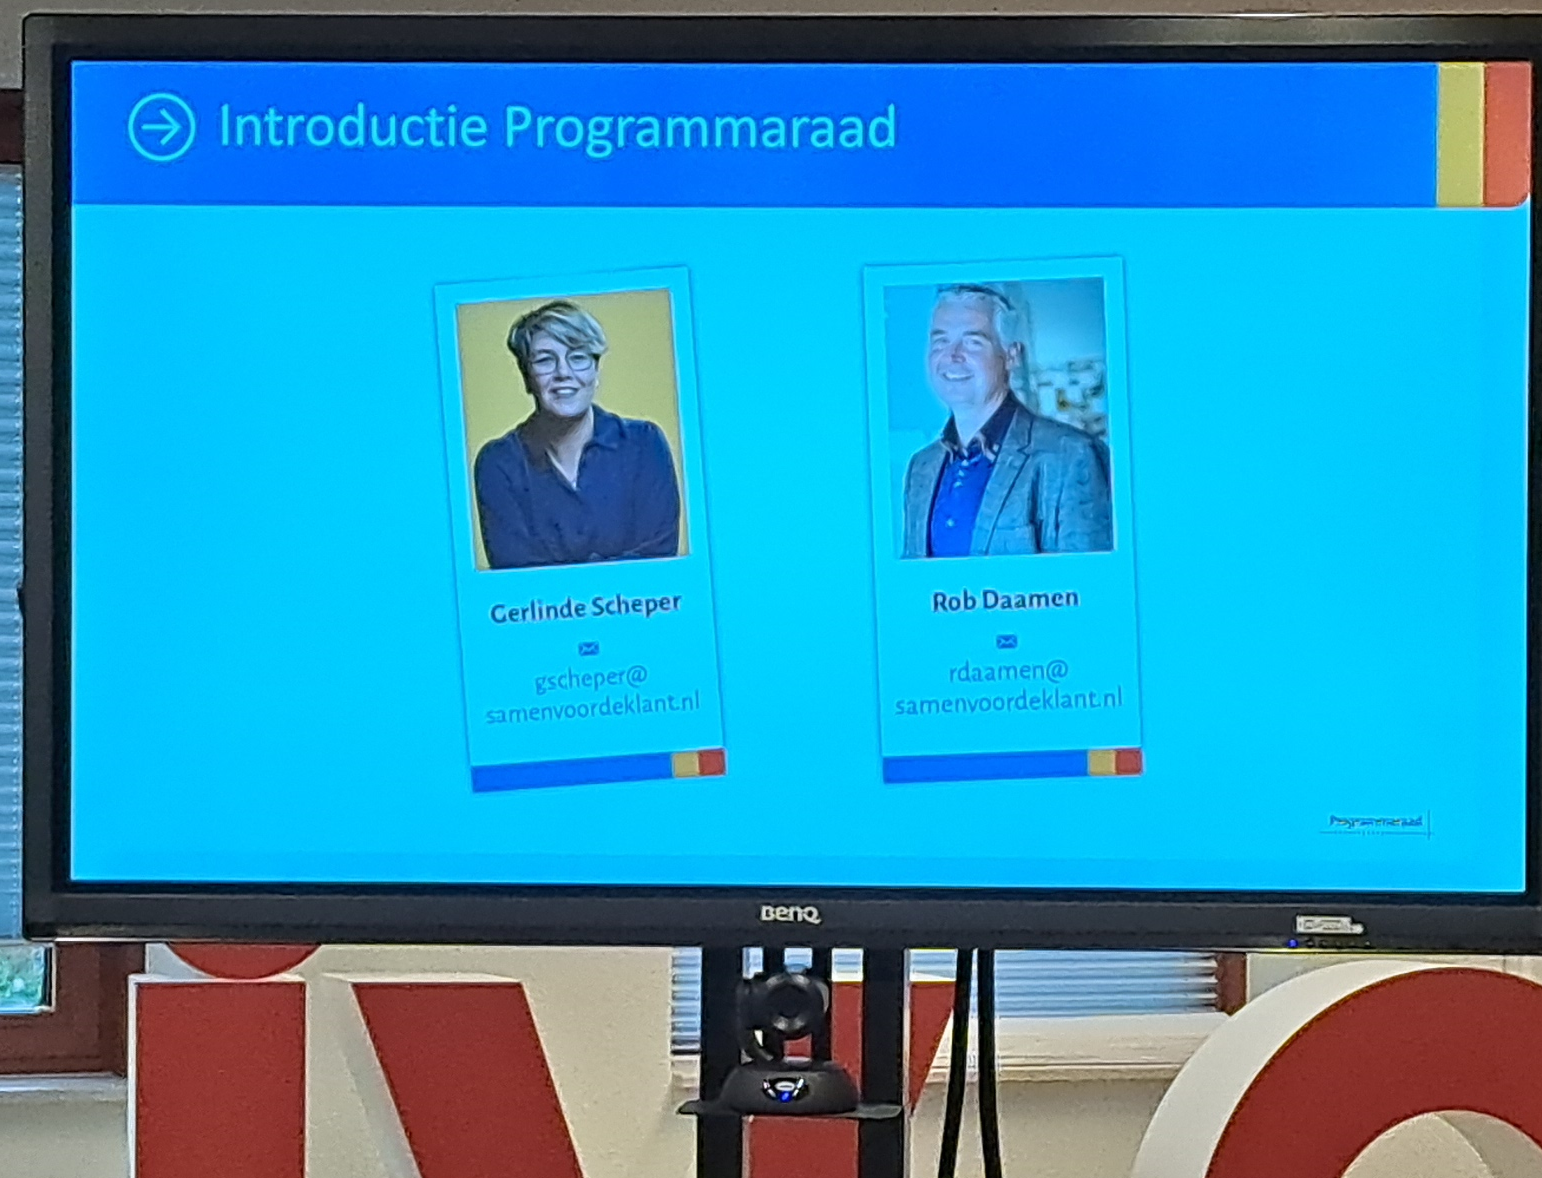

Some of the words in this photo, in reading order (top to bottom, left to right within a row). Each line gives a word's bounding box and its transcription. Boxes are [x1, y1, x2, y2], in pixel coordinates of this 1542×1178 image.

[220, 104, 488, 149] Introductie
[505, 104, 898, 159] Programmaraad
[490, 597, 587, 624] Gerlinde
[591, 593, 682, 619] Scheper
[932, 588, 977, 613] Rob
[982, 589, 1080, 610] Daamen
[534, 664, 648, 696] gscheper@
[949, 659, 1069, 684] rdaamen@
[485, 688, 700, 725] samenvoordeklant.nl
[894, 684, 1123, 716] samenvoordeklant.nl
